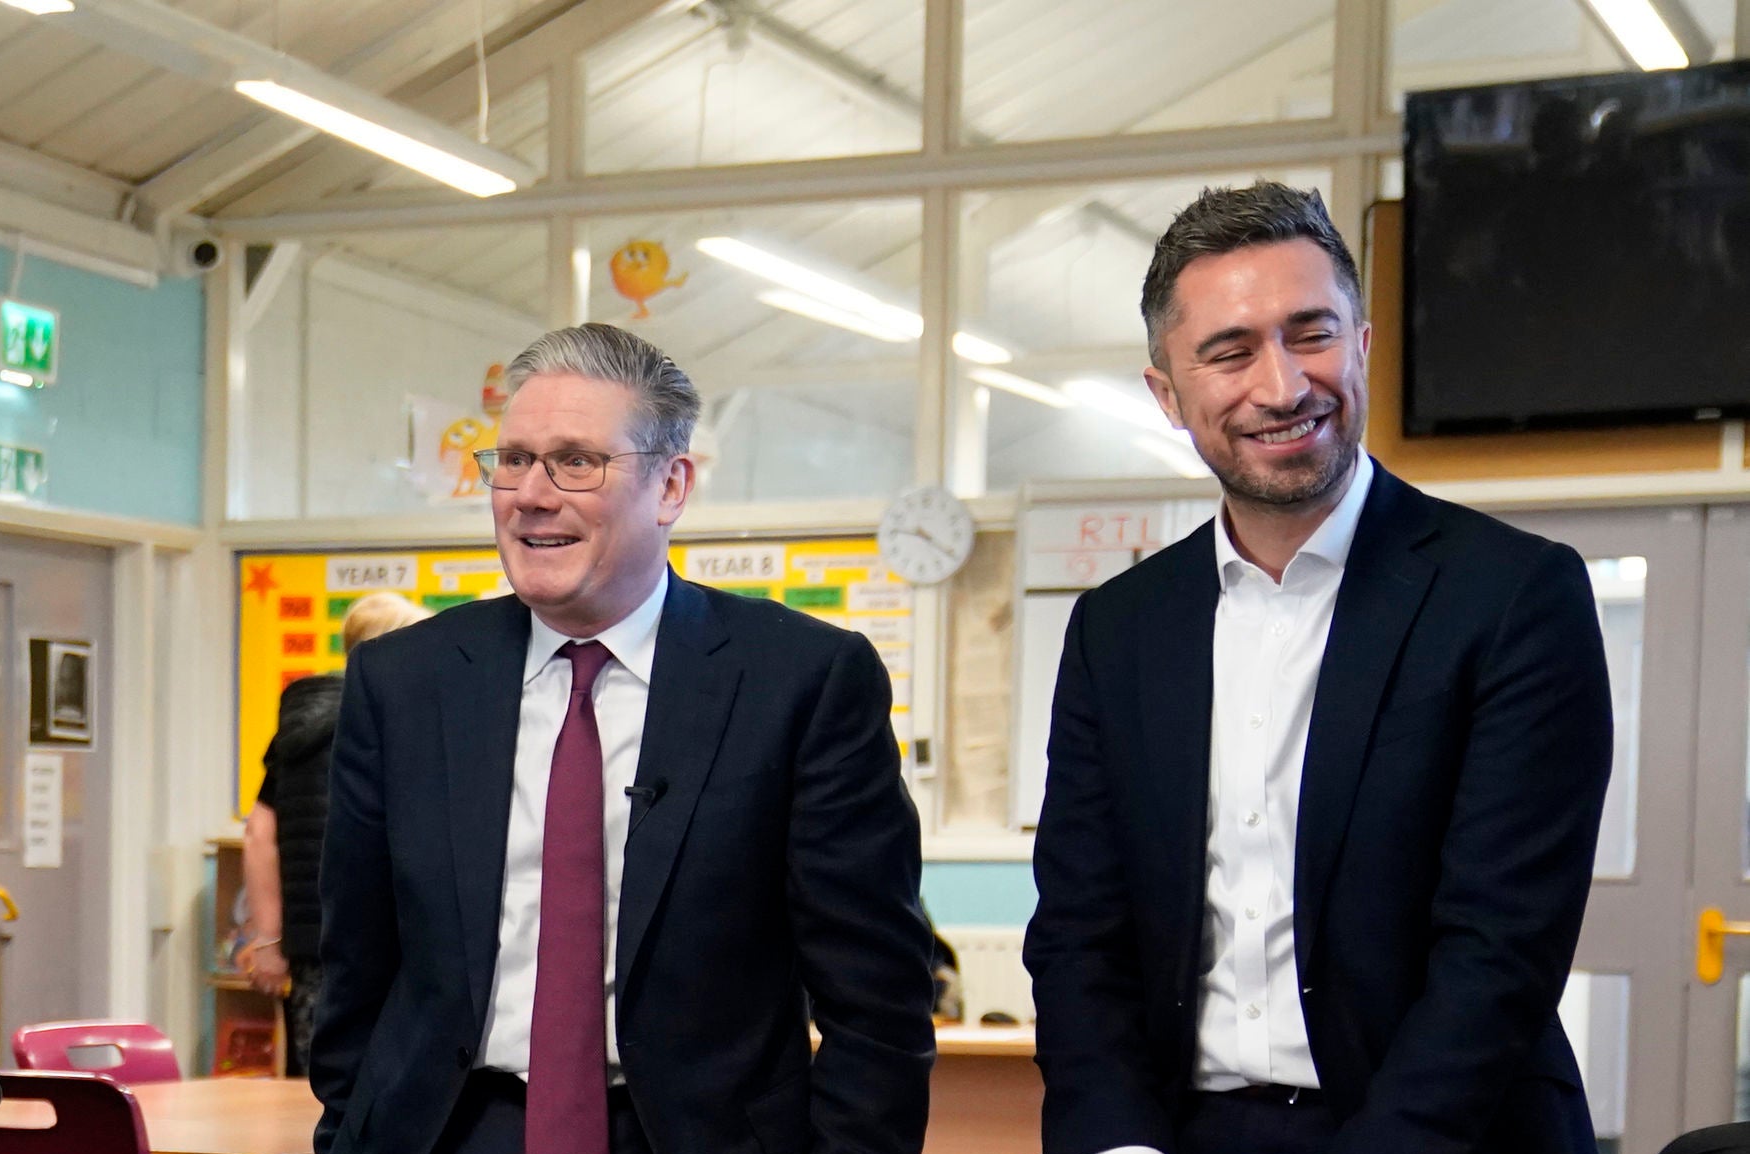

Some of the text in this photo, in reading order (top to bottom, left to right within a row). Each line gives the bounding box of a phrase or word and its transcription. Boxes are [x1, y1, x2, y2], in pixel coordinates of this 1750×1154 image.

[1080, 513, 1162, 547] RTL
[336, 565, 387, 587] YEAR
[397, 564, 408, 584] 7
[697, 556, 773, 577] YEAR 8
